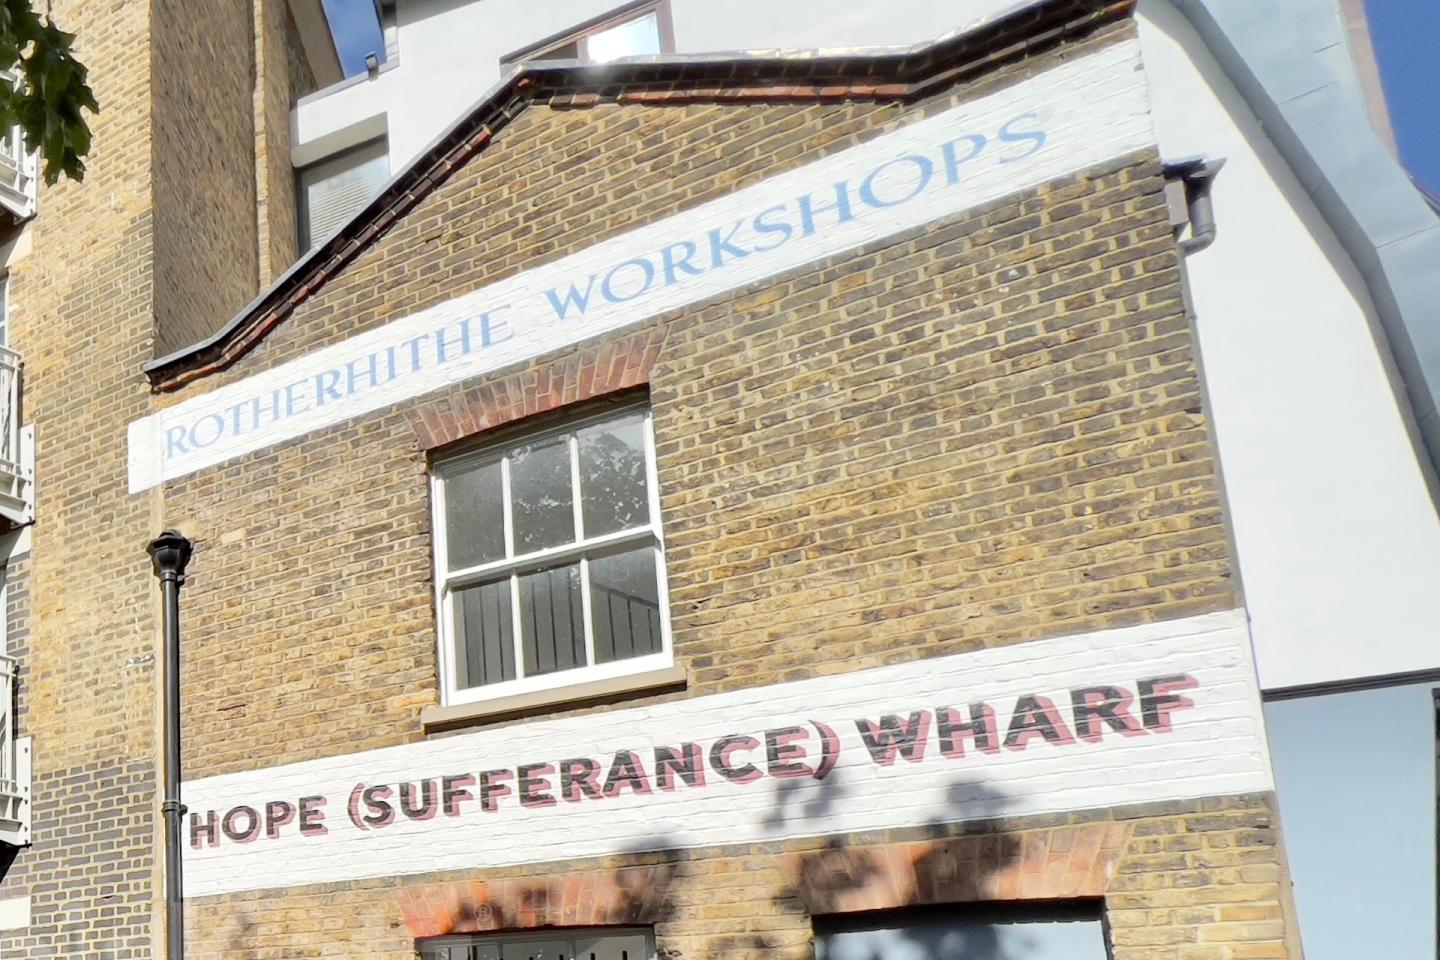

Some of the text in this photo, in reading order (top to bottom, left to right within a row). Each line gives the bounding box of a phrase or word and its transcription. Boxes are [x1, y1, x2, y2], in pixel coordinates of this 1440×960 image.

[165, 112, 1049, 459] ROTHERHITHE WORKSHOPS
[189, 673, 1200, 849] HOPE (SUFFERANCE) WHARF
